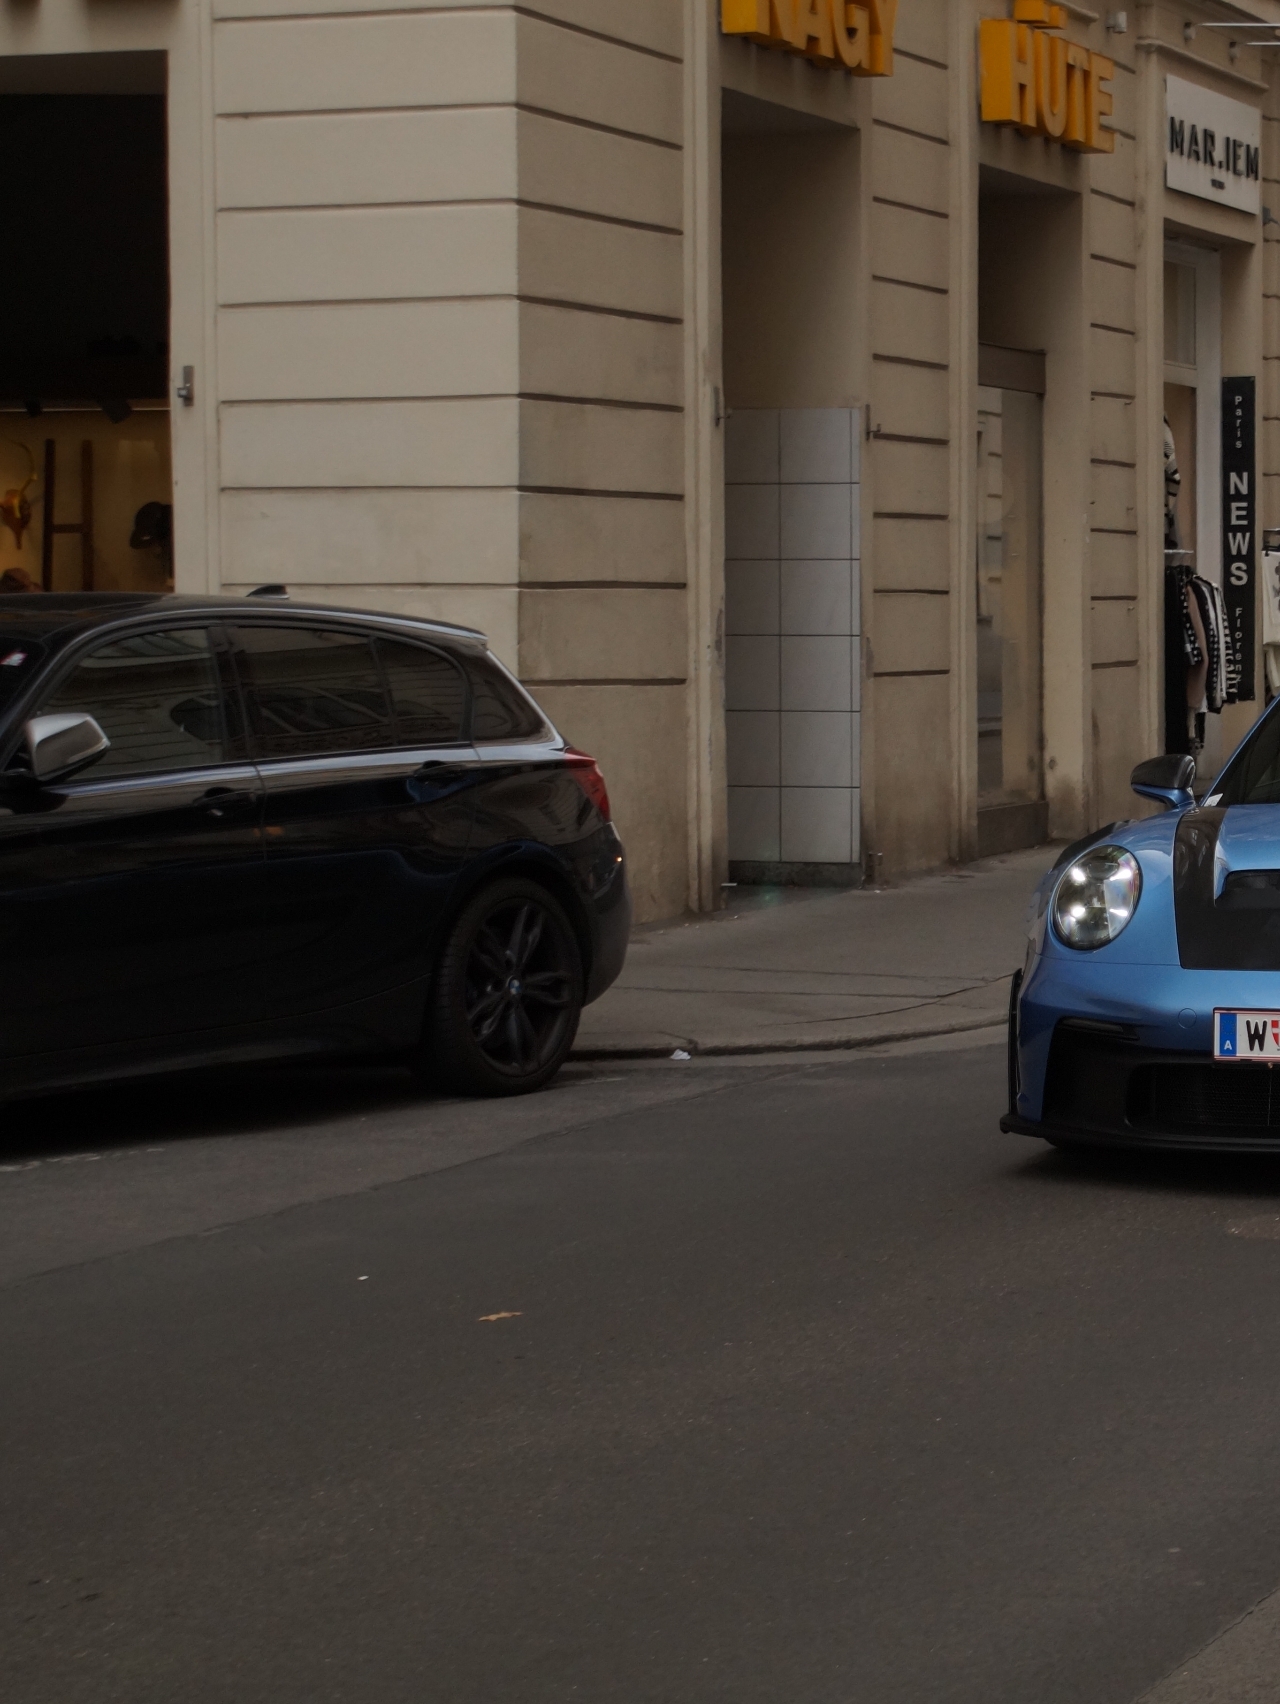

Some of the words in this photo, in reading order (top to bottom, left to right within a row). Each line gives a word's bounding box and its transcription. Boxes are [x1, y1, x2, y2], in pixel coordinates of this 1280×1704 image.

[979, 0, 1115, 154] HÜTE
[1234, 395, 1242, 448] Paris
[1228, 472, 1250, 585] NEWS
[1223, 1040, 1233, 1050] A
[1245, 1019, 1268, 1051] W
